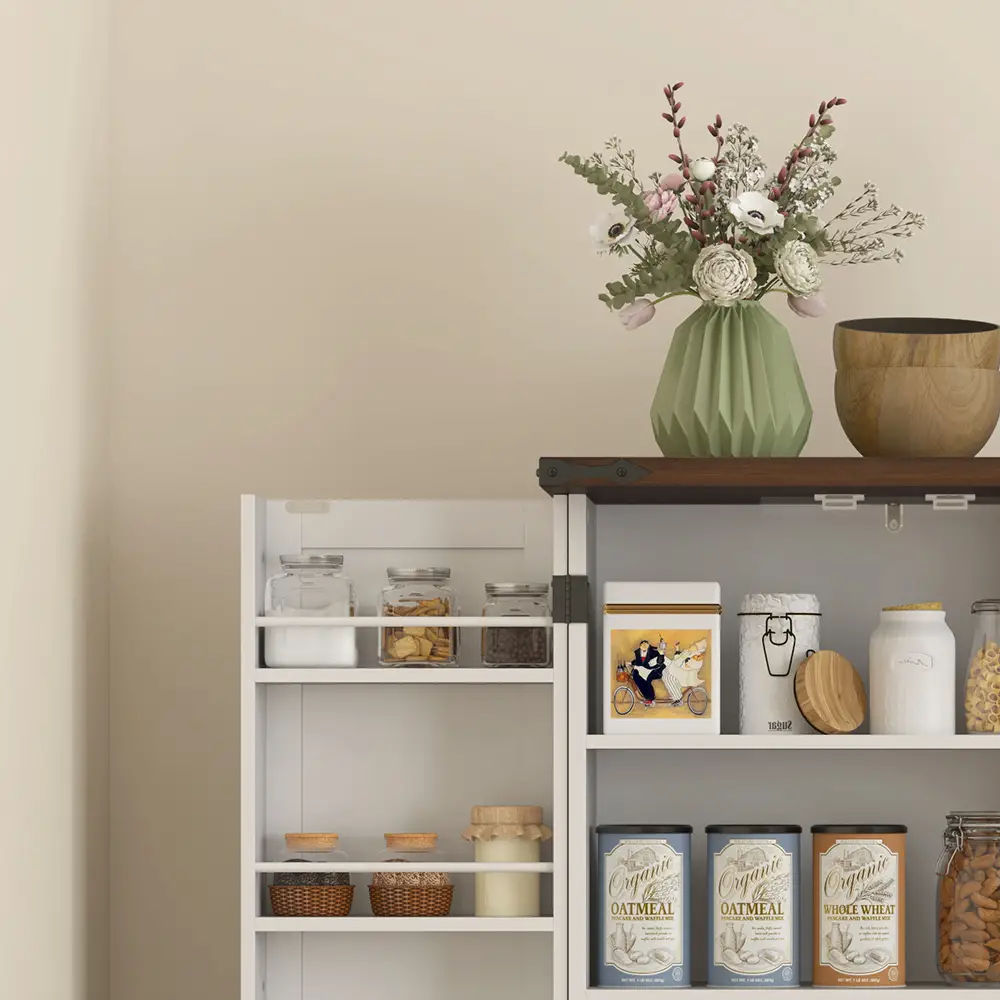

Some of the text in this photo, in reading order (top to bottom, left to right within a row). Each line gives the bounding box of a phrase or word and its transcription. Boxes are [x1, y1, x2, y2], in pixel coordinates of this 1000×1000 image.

[609, 855, 672, 900] Organic
[719, 855, 782, 900] Organic
[824, 855, 888, 900] Organic
[611, 902, 674, 915] OATMEAL
[721, 902, 784, 915] OATMEAL
[823, 904, 895, 915] WHOLE WHEAT
